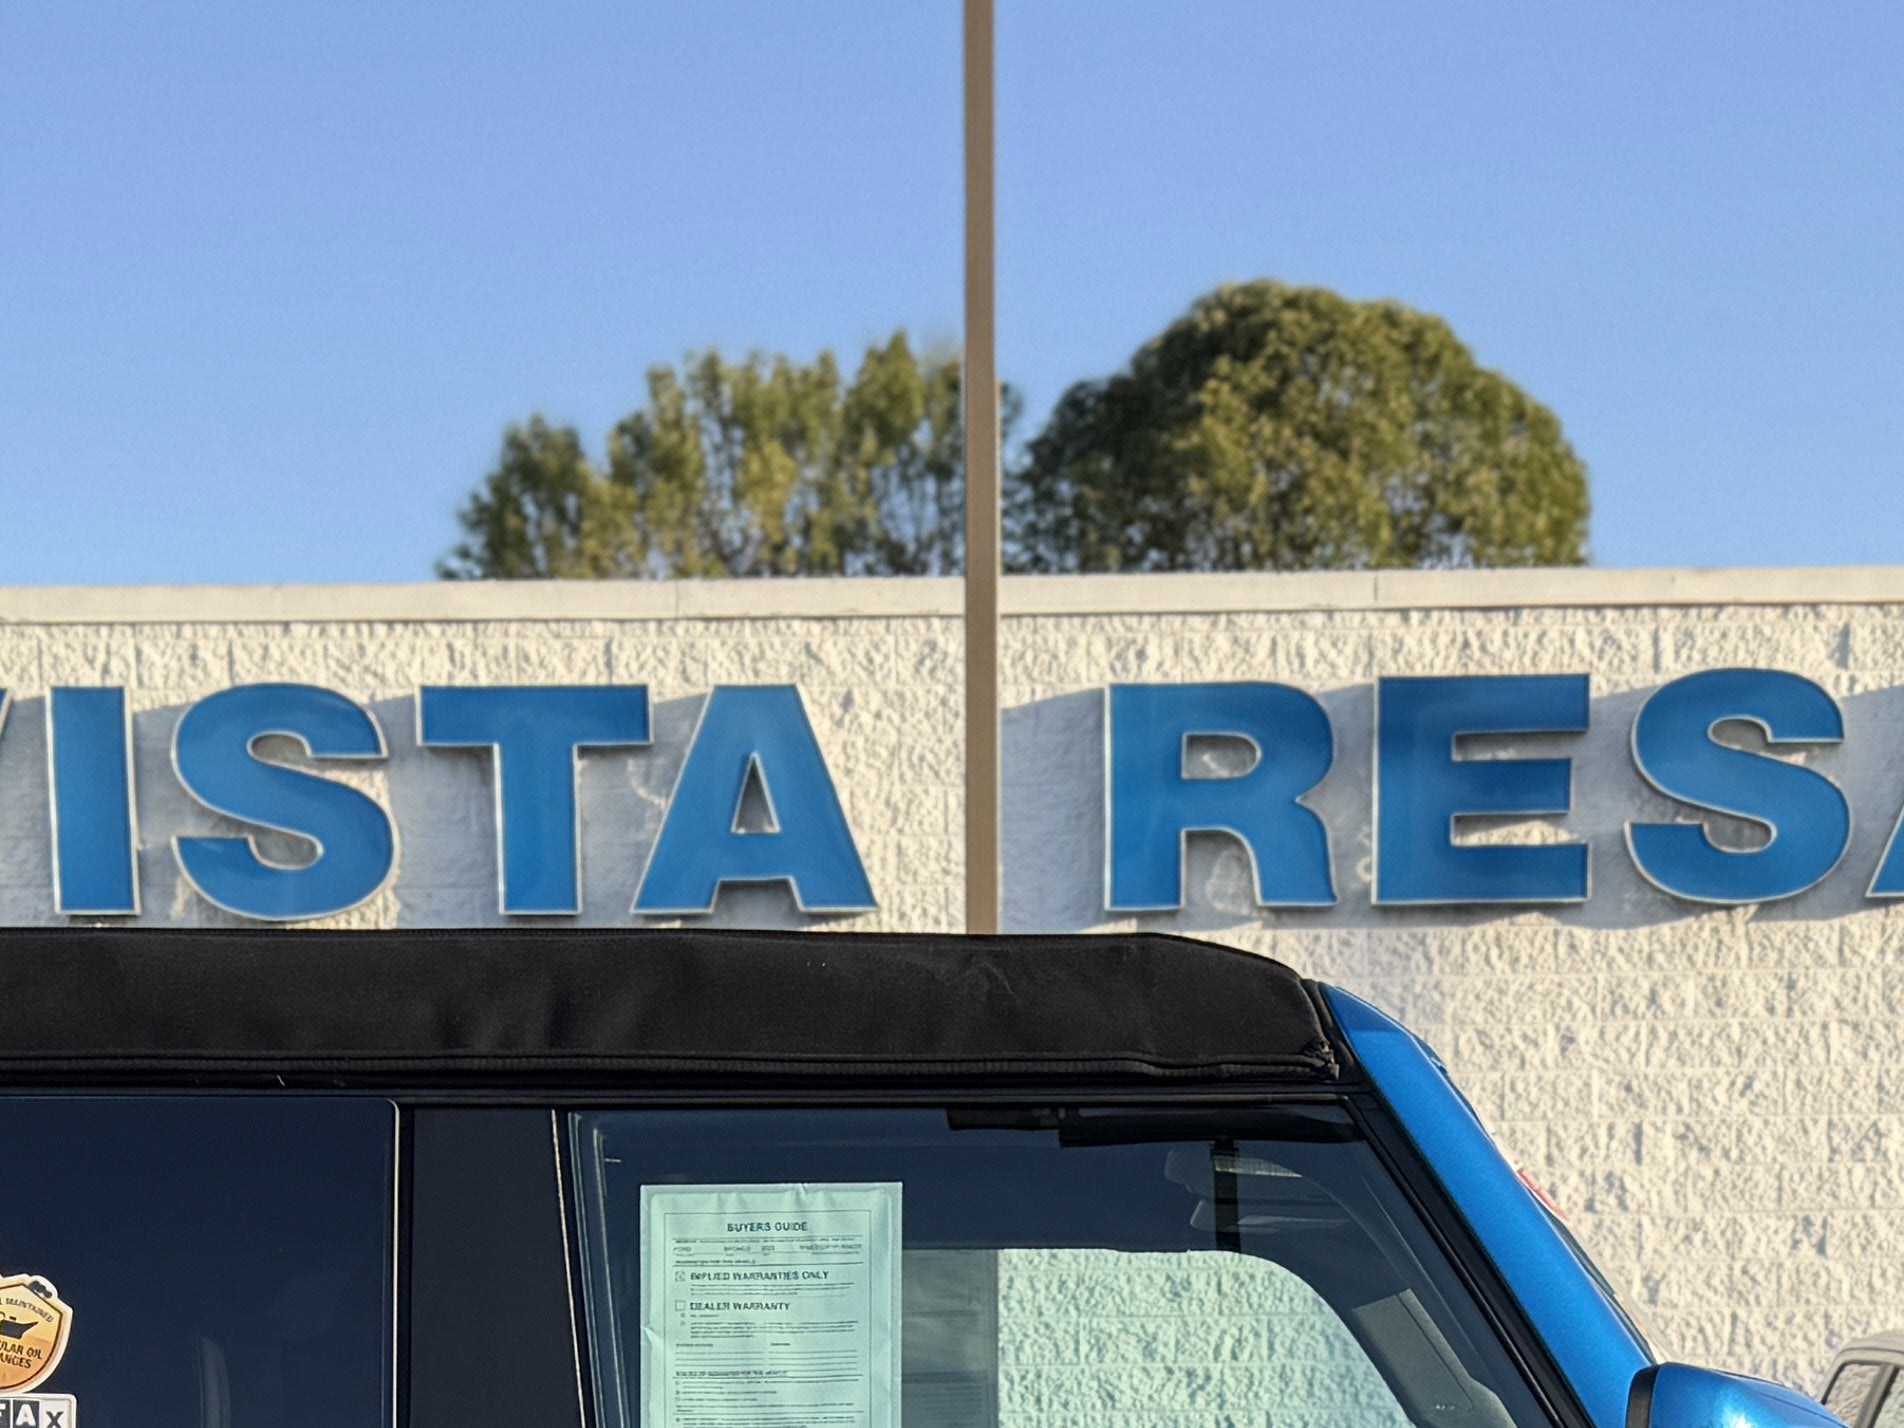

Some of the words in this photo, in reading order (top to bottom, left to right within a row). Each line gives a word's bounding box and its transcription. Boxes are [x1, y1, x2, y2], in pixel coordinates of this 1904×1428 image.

[727, 1222, 771, 1232] BUYERS
[775, 1222, 808, 1231] GUIDE
[733, 1271, 799, 1280] WARRANTIES
[802, 1271, 829, 1279] ONLY
[5, 1297, 54, 1323] MAINTAINED
[690, 1302, 730, 1311] DEALER
[733, 1302, 790, 1310] WARRANTY
[26, 1347, 42, 1359] OIL
